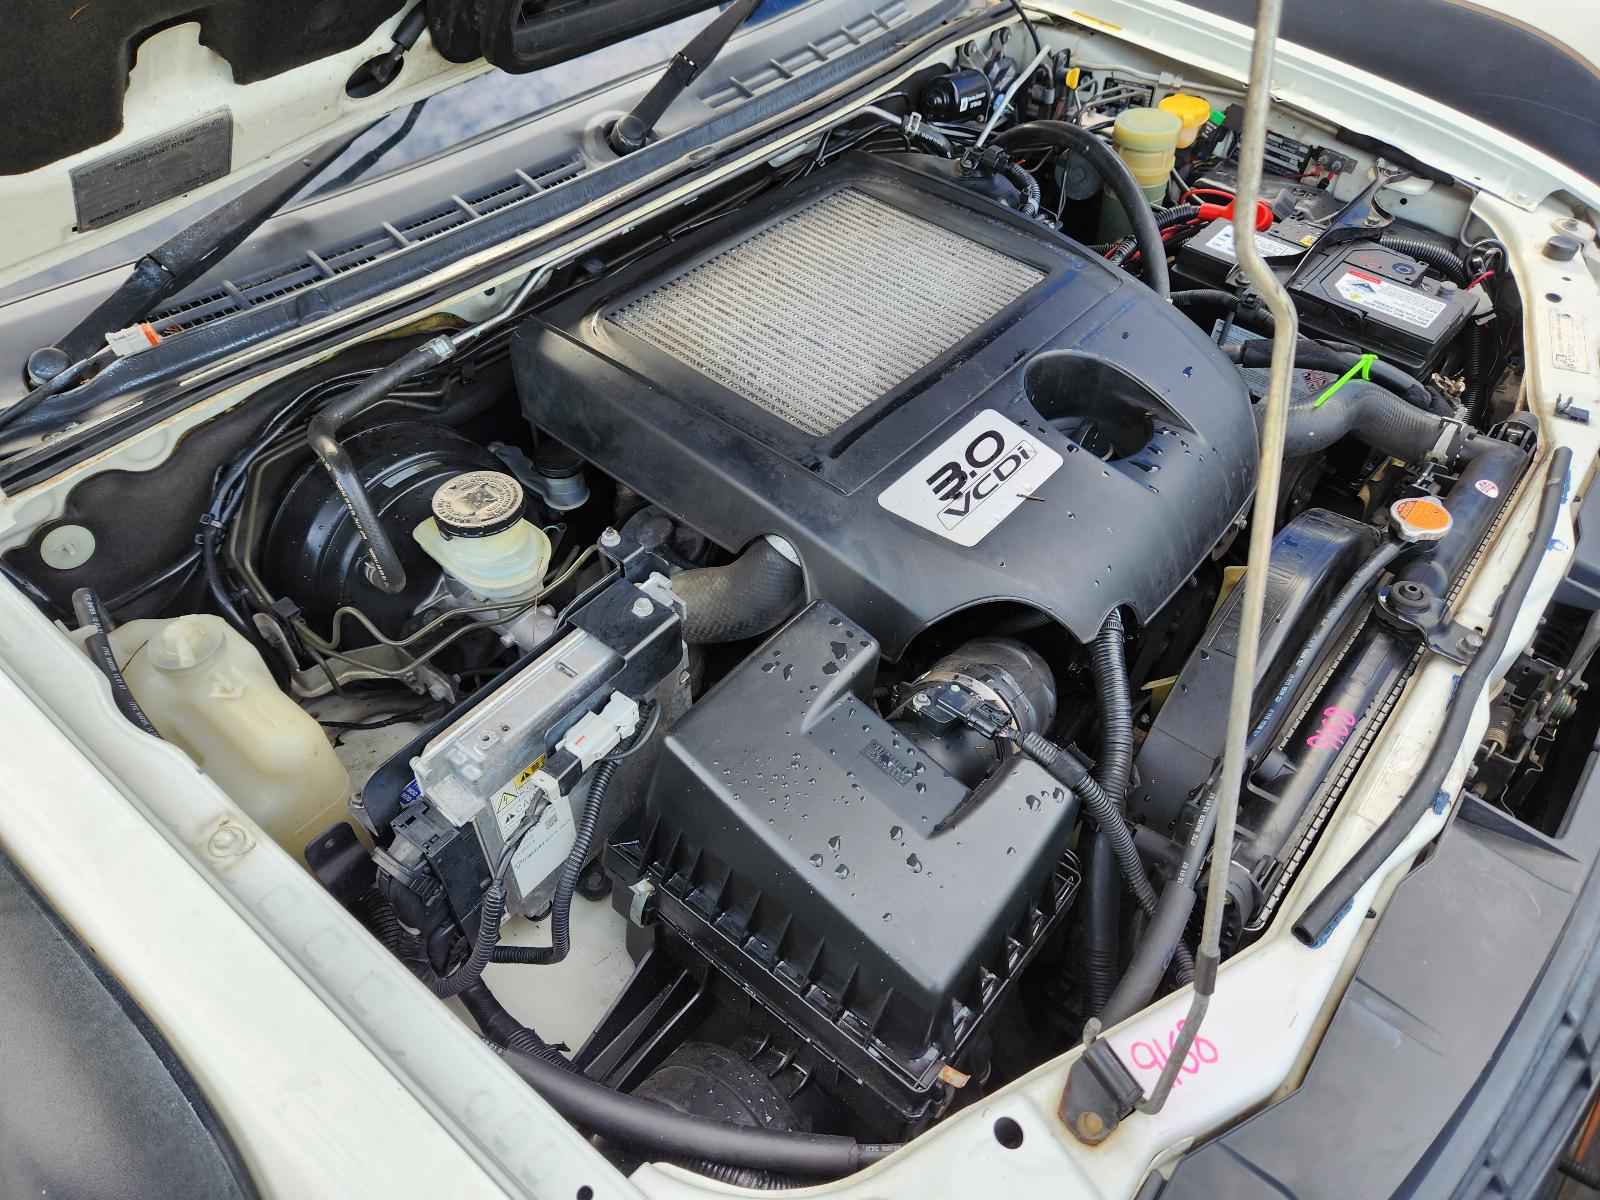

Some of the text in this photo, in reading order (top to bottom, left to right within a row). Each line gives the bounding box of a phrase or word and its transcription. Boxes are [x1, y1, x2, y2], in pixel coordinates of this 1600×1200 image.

[114, 144, 171, 172] REFRIGERANT
[926, 429, 1005, 501] 3.0
[943, 446, 1031, 517] VCDi
[1194, 814, 1206, 833] WATER
